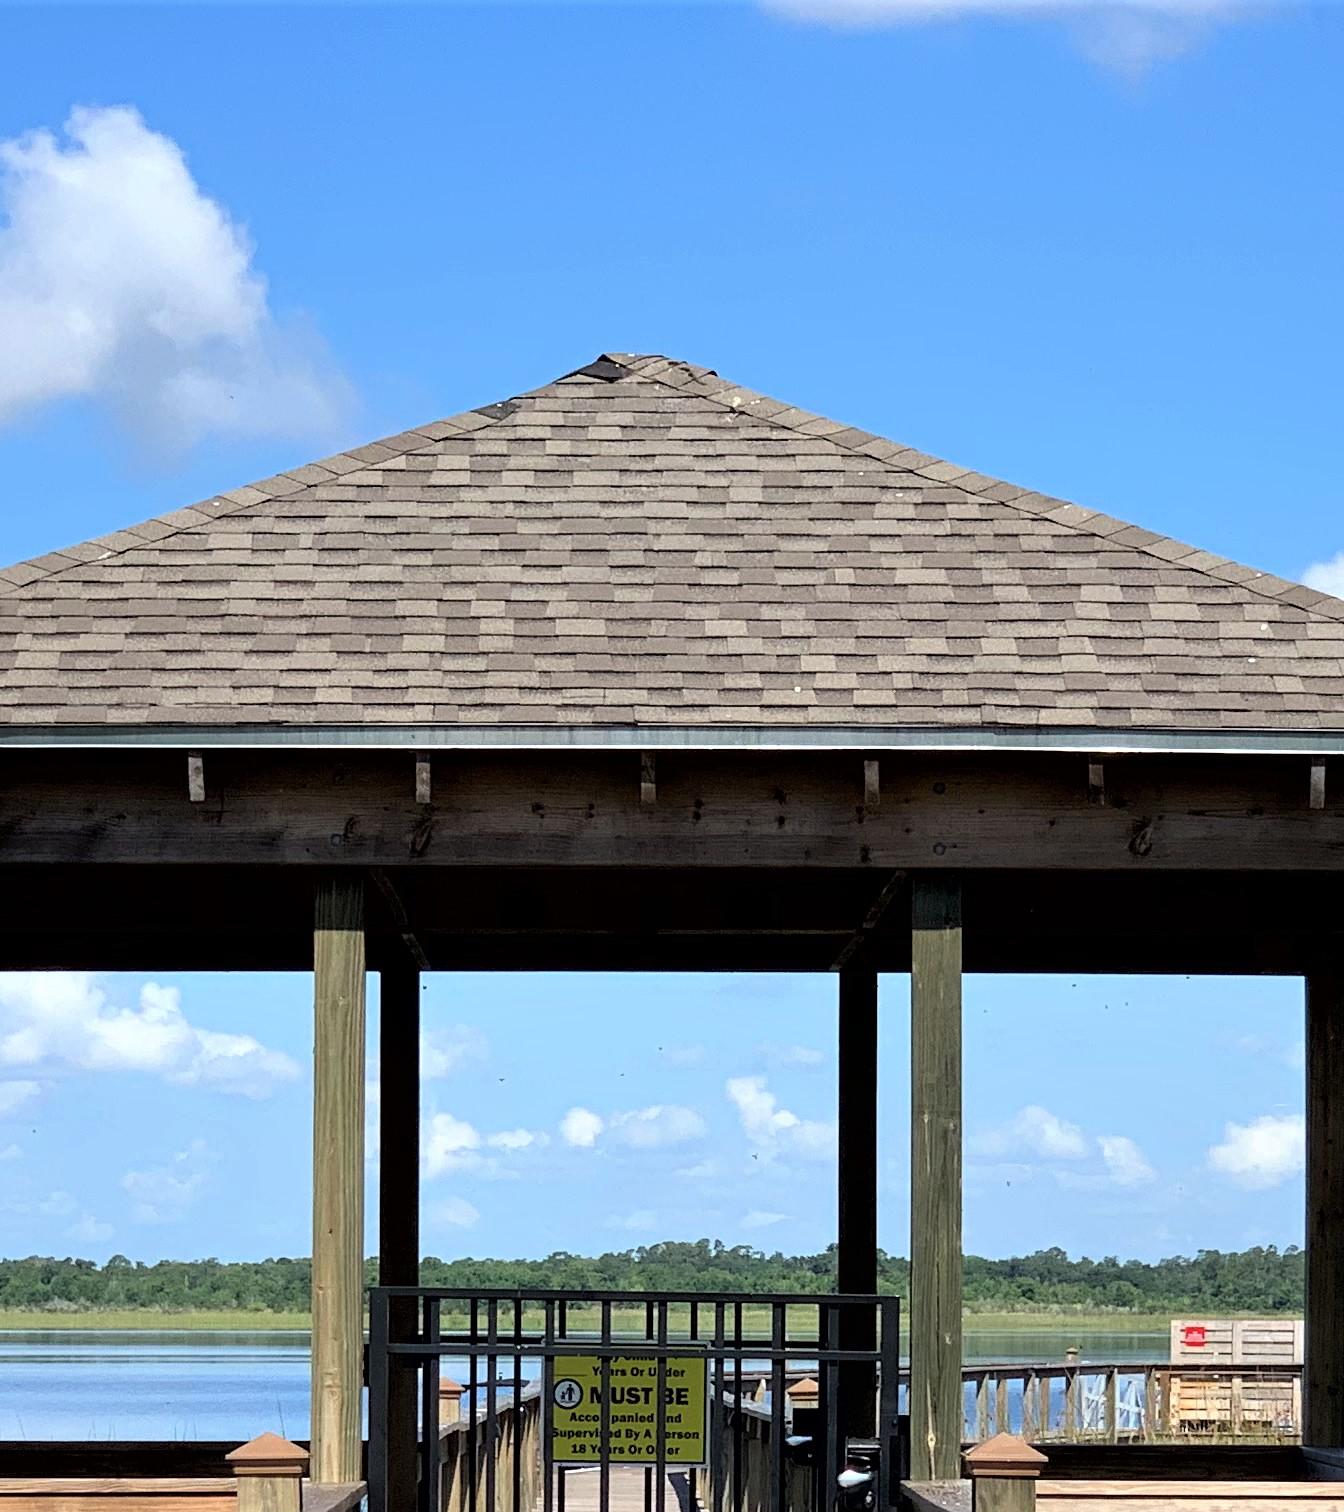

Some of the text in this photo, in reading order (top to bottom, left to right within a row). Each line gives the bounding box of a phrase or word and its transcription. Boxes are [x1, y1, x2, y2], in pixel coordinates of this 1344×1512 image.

[592, 1366, 685, 1377] Yrs Or Uder
[662, 1387, 689, 1405] BE
[569, 1412, 681, 1424] Accopanied nd
[551, 1428, 699, 1441] Supervied By A erson
[571, 1443, 586, 1453] 18
[629, 1445, 642, 1454] Or
[646, 1445, 680, 1455] Oer
